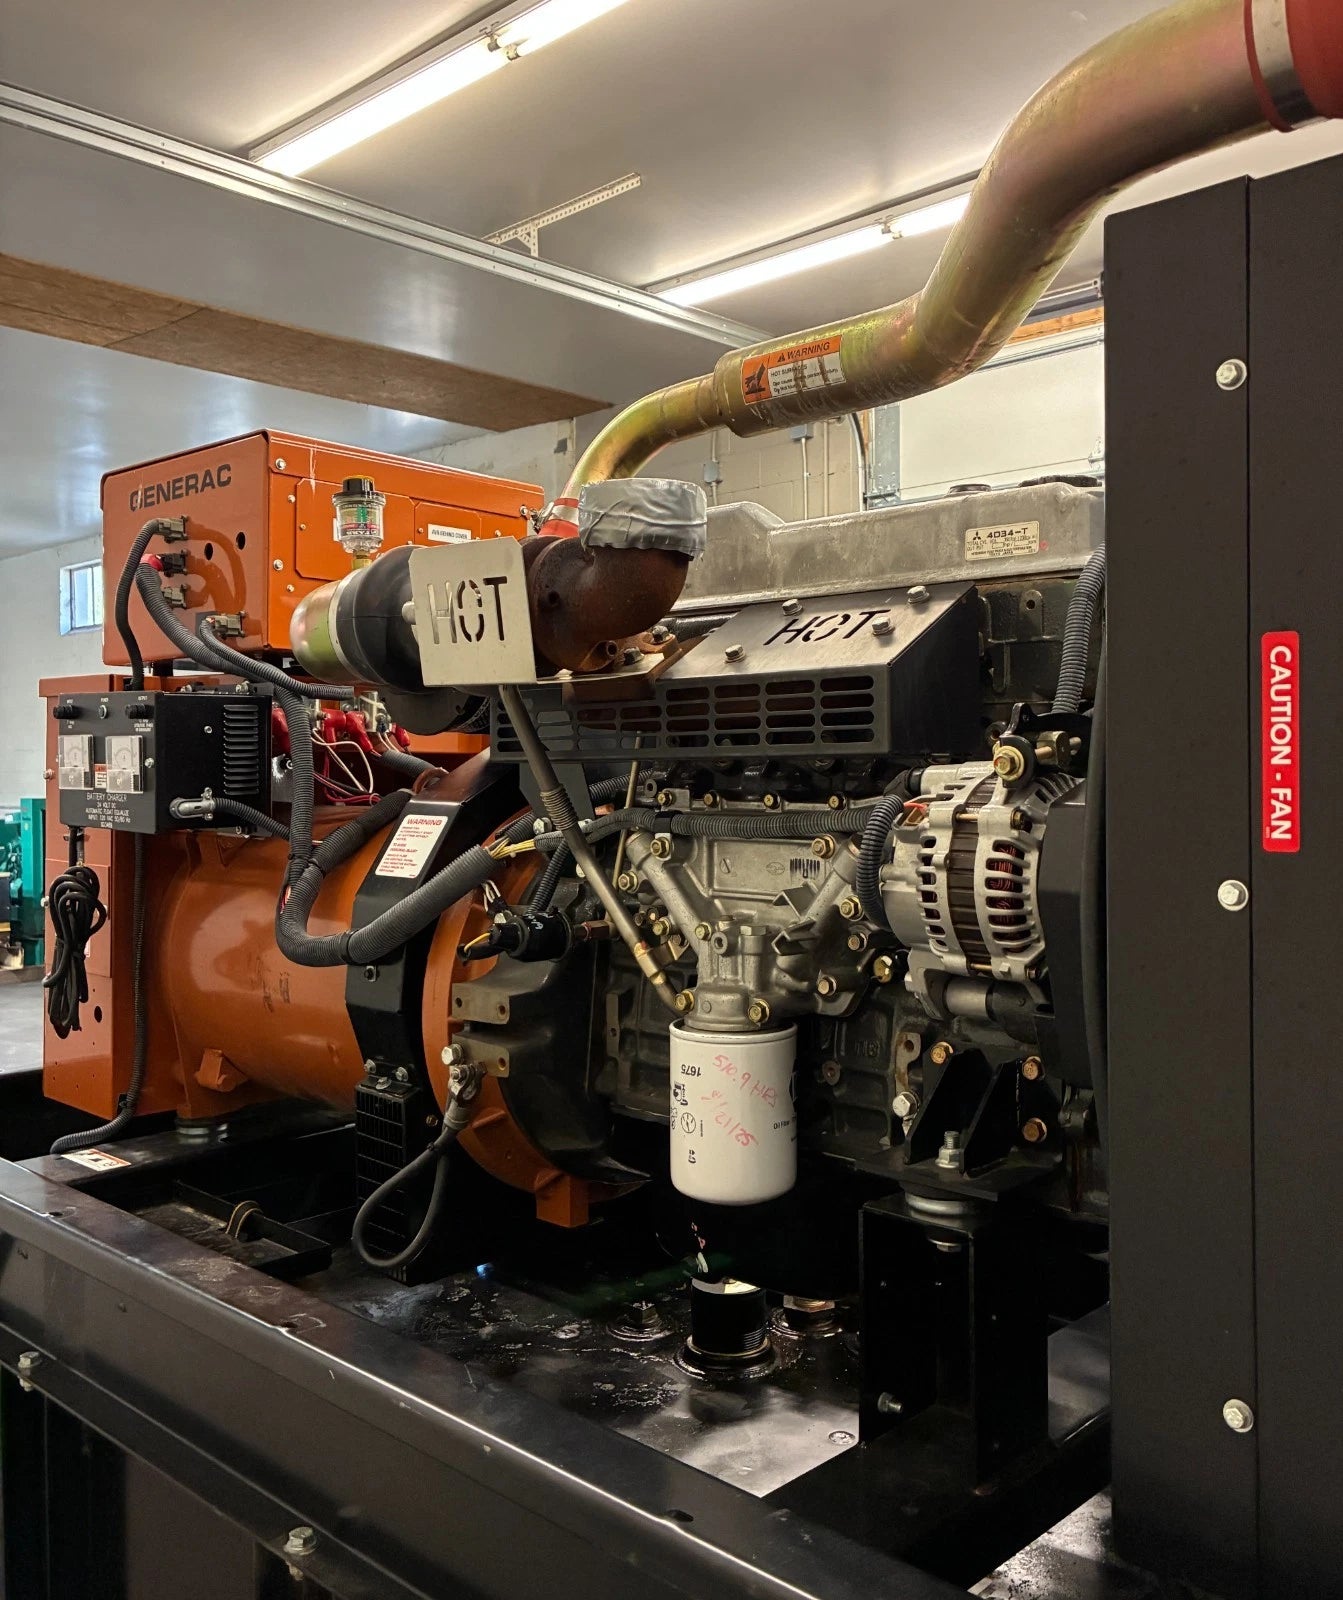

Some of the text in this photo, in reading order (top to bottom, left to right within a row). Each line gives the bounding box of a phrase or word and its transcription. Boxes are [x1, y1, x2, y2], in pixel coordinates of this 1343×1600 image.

[787, 341, 830, 360] WARNING
[771, 370, 781, 378] HOT
[129, 463, 232, 512] GENERAC
[986, 527, 1028, 539] 4D34-T
[427, 575, 507, 645] HOT
[763, 609, 891, 646] HOT
[1269, 645, 1292, 765] CAUTION
[86, 792, 128, 802] BATTERY CHARGER
[406, 818, 443, 826] WARNING
[1270, 787, 1292, 840] FAN
[680, 1063, 702, 1077] 1675
